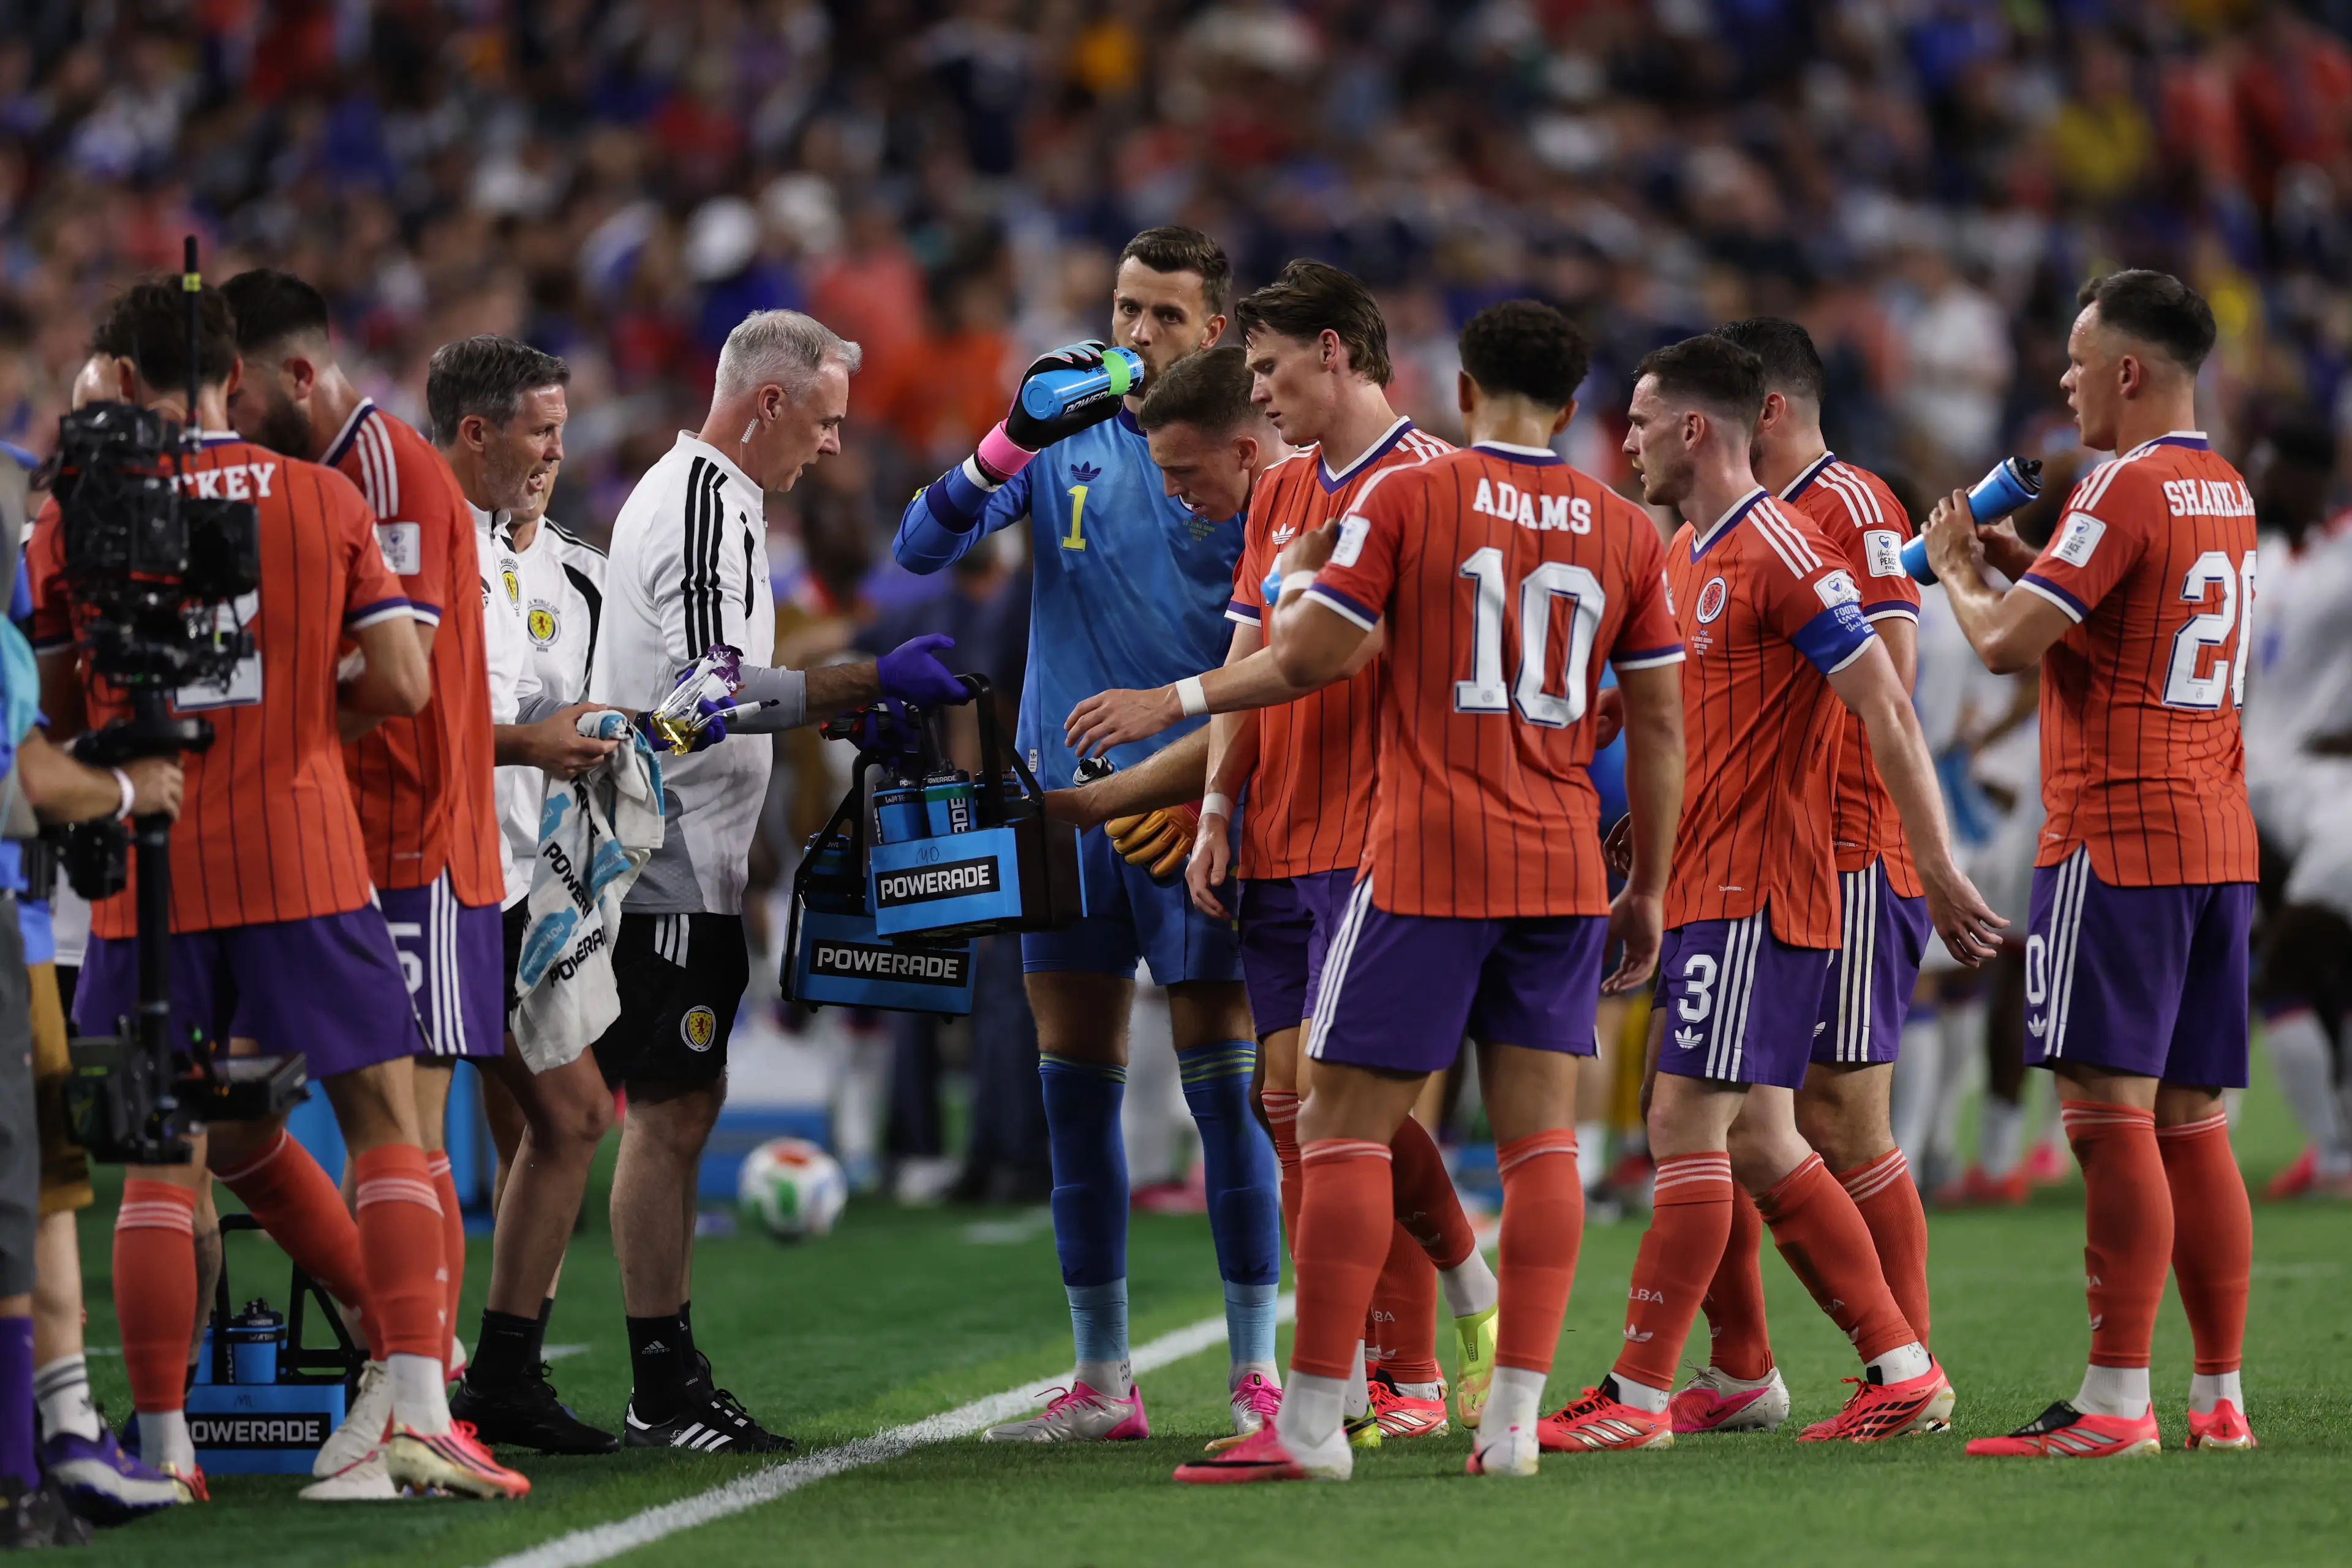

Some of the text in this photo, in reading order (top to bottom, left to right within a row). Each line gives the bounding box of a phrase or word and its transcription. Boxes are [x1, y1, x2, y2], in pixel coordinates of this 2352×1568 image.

[1472, 478, 1592, 535] ADAMS
[2163, 479, 2256, 517] SHANKLA
[1060, 485, 1088, 551] 1
[1454, 546, 1606, 729] 10
[885, 794, 906, 804] WATE
[880, 864, 990, 900] POWERADE
[817, 948, 959, 979] POWERADE
[1677, 954, 1717, 1023] 3
[1629, 1287, 1664, 1305] LBA
[1371, 1307, 1395, 1322] LBA
[186, 1420, 320, 1442] OWERADE
